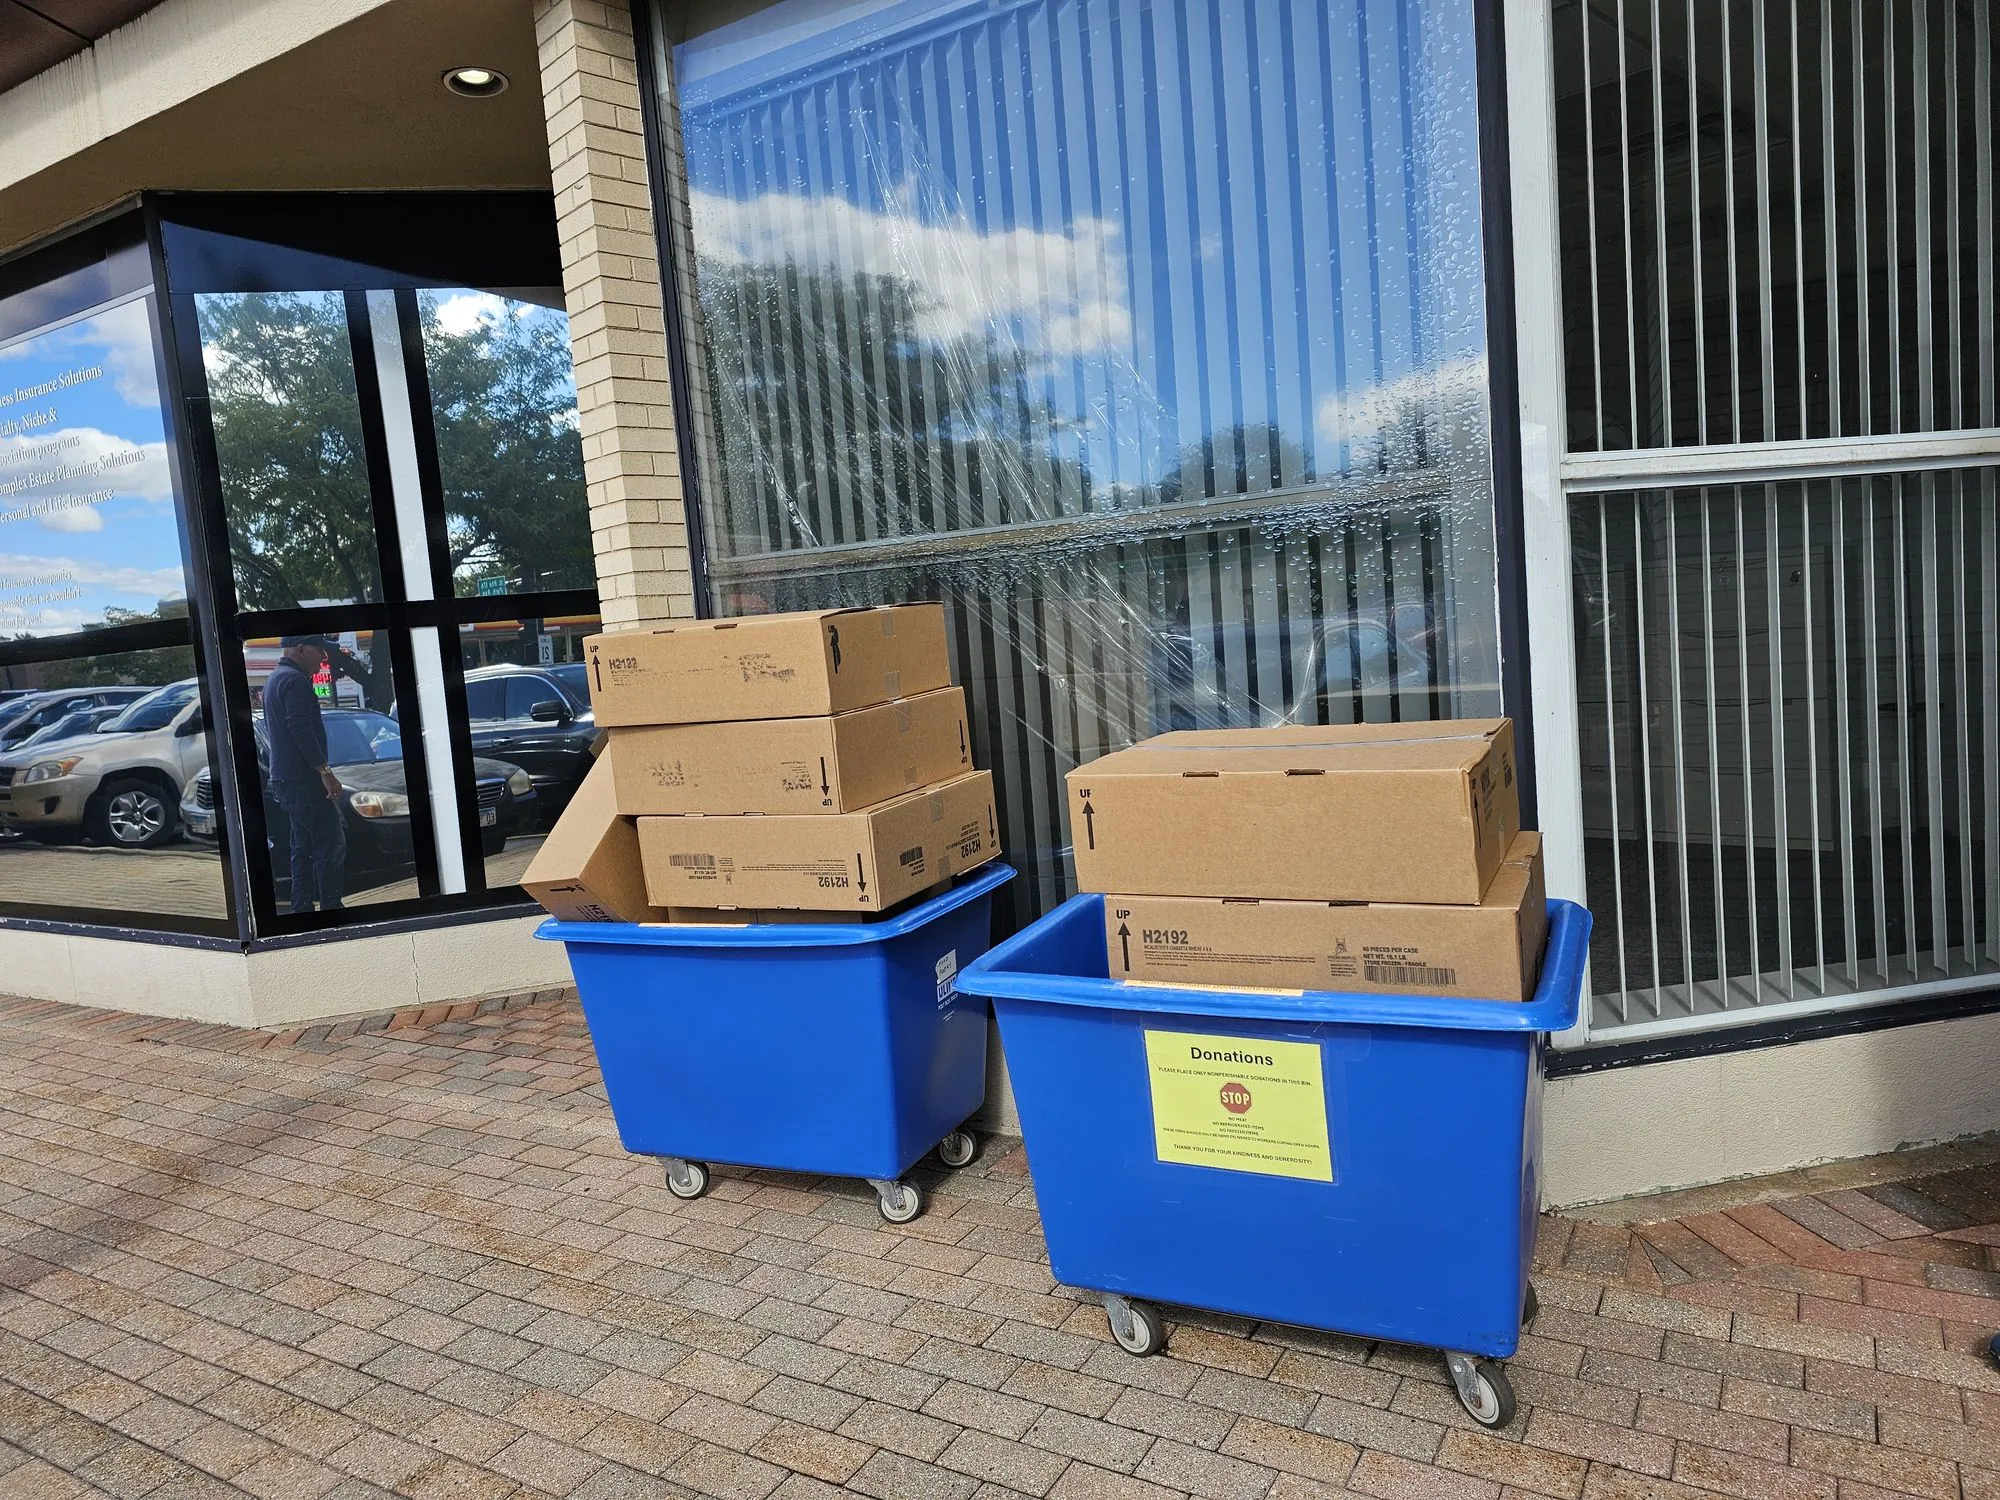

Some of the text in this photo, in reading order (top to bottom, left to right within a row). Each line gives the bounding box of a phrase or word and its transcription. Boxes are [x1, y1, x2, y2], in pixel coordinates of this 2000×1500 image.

[15, 380, 58, 402] Insurance
[59, 365, 103, 390] Solutions
[22, 410, 48, 430] Niche
[49, 406, 58, 424] &
[38, 436, 80, 460] programs
[29, 471, 55, 488] Estate
[56, 460, 99, 481] Planning
[100, 450, 146, 471] Solutions
[32, 497, 48, 516] and
[49, 495, 68, 512] Life
[69, 488, 114, 508] Insurance
[962, 839, 980, 858] H2192
[819, 877, 849, 888] H2192
[1116, 910, 1130, 919] UP
[1143, 929, 1189, 944] H2192
[1191, 1047, 1274, 1066] Donations
[1207, 1071, 1249, 1080] NONPERISHABLE
[1221, 1091, 1250, 1106] STOP
